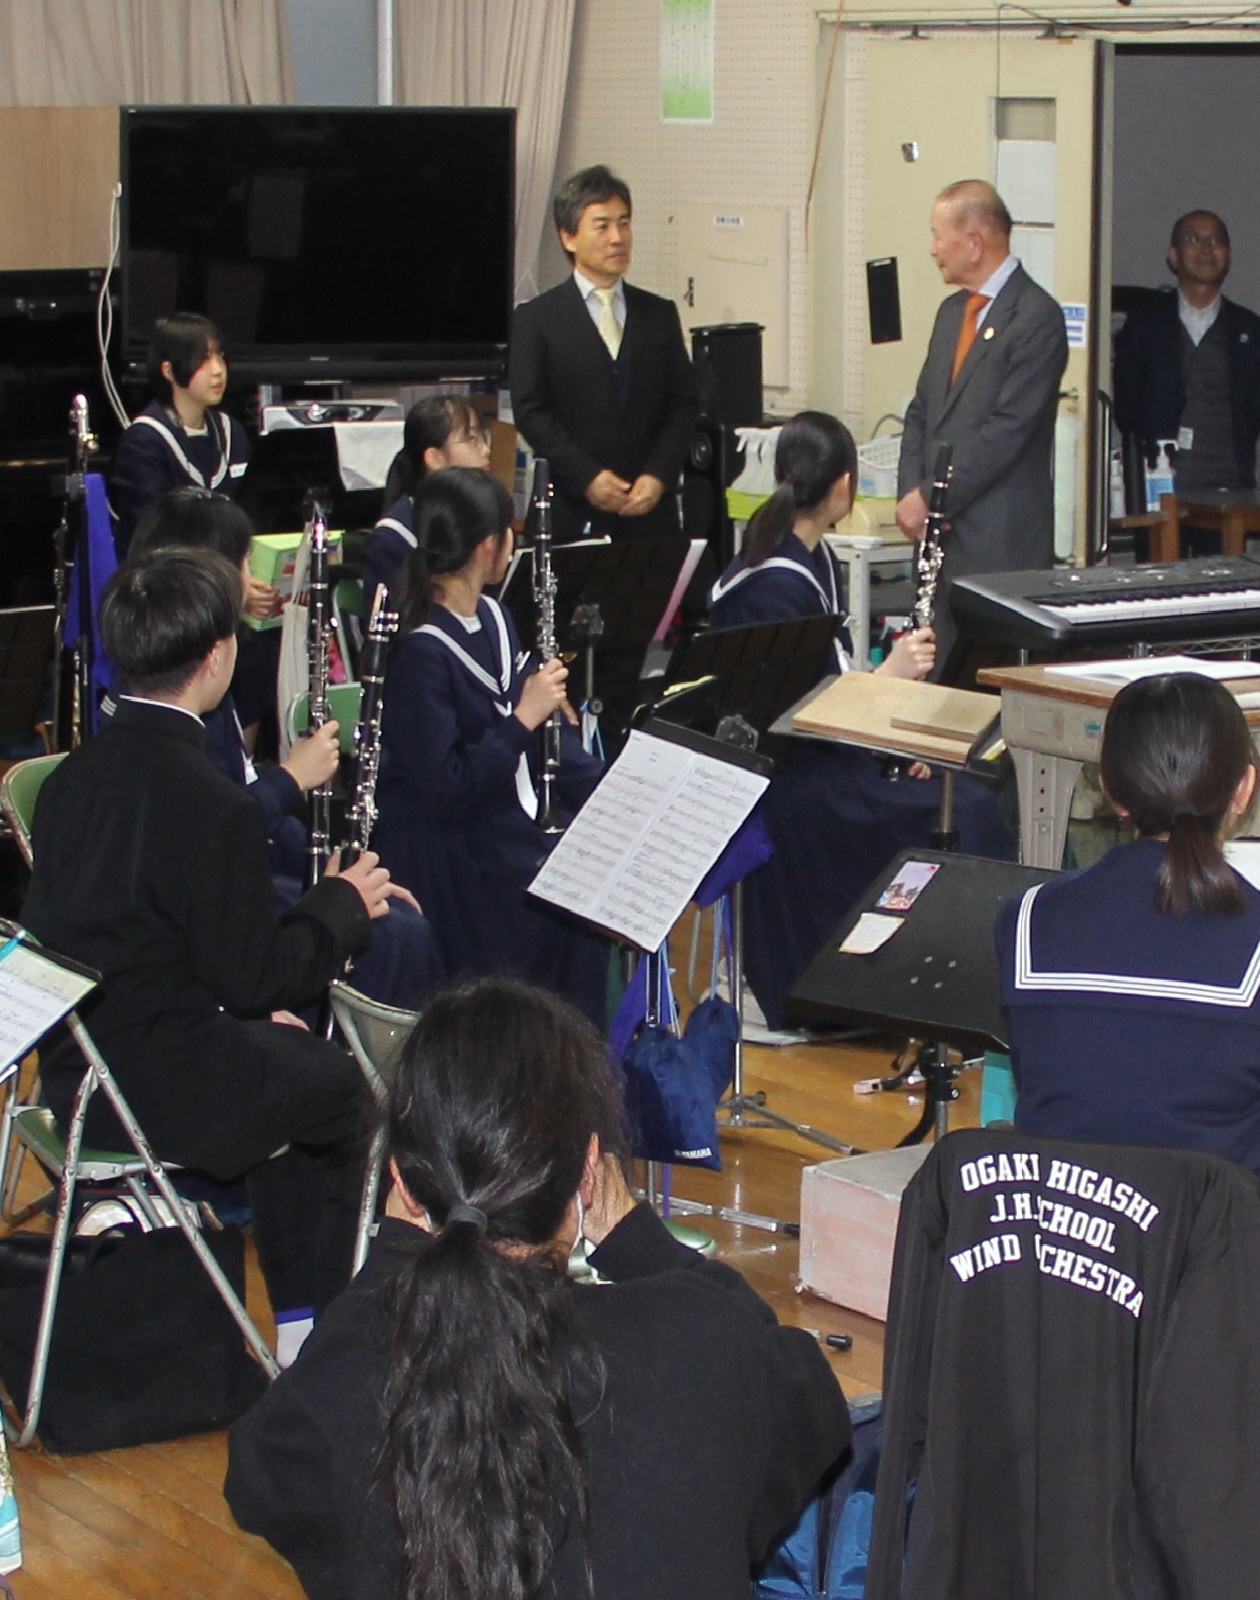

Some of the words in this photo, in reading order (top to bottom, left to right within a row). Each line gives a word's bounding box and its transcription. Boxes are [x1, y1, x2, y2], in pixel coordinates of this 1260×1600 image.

[960, 1153, 1040, 1191] OGAKI
[1046, 1160, 1160, 1232] HIGASHI
[990, 1193, 1038, 1223] J.H.
[1037, 1195, 1117, 1254] CHOOL
[950, 1234, 1021, 1282] WIND
[1034, 1234, 1145, 1318] CHESTRA
